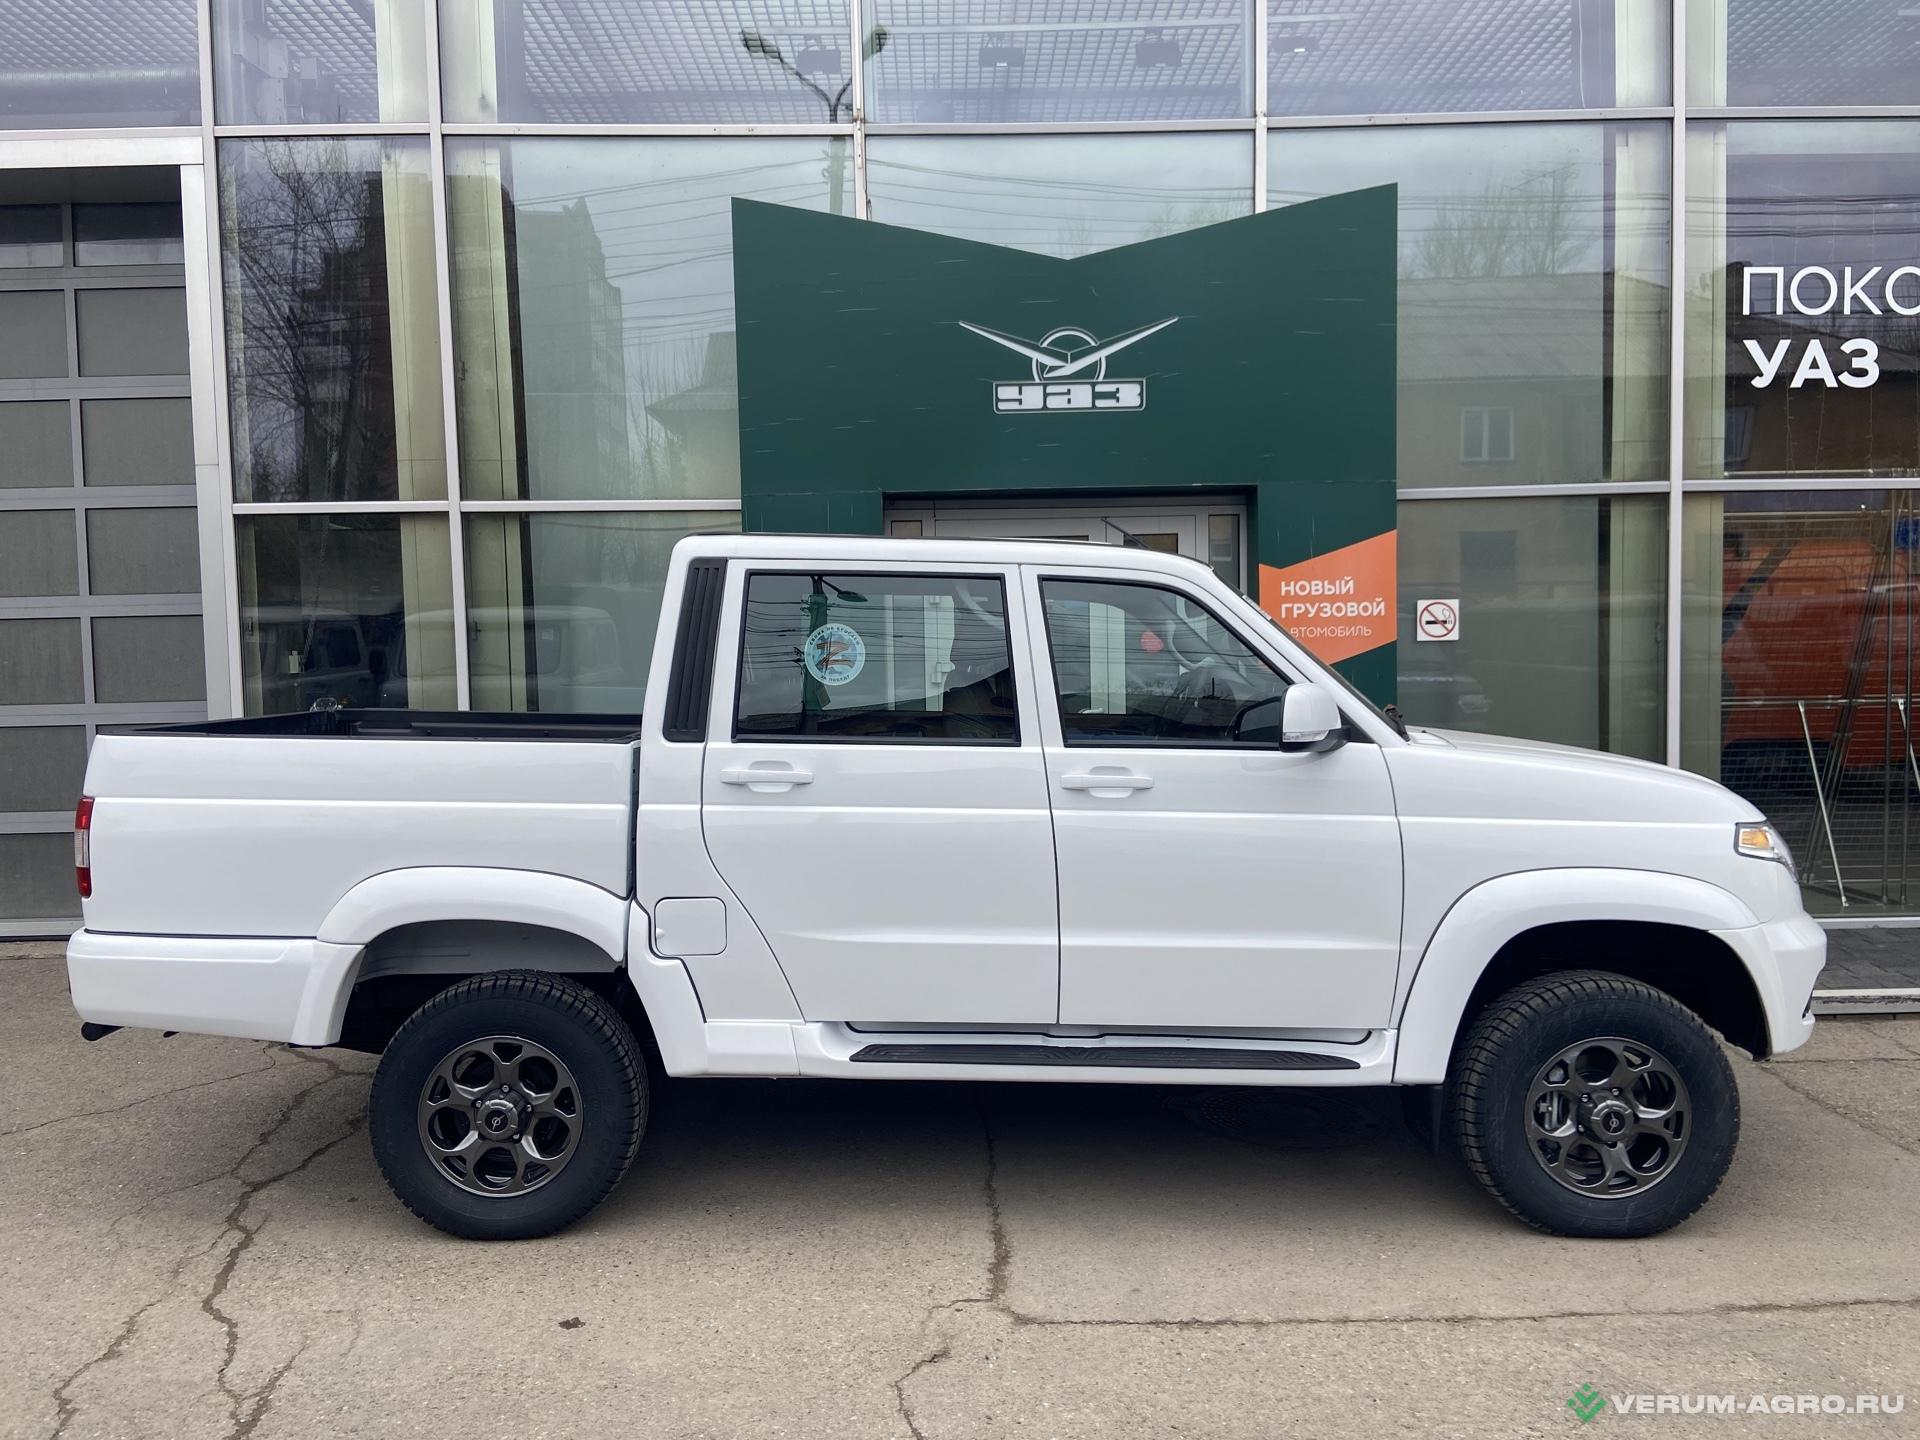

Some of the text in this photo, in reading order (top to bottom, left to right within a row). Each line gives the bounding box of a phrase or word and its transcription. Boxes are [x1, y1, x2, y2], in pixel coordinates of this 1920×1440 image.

[1742, 337, 1880, 389] УАЗ
[1280, 576, 1355, 596] НОВЫЙ
[1280, 598, 1386, 619] ГРУЗОВОЙ
[1290, 624, 1373, 638] ВТОМОБИЛЬ
